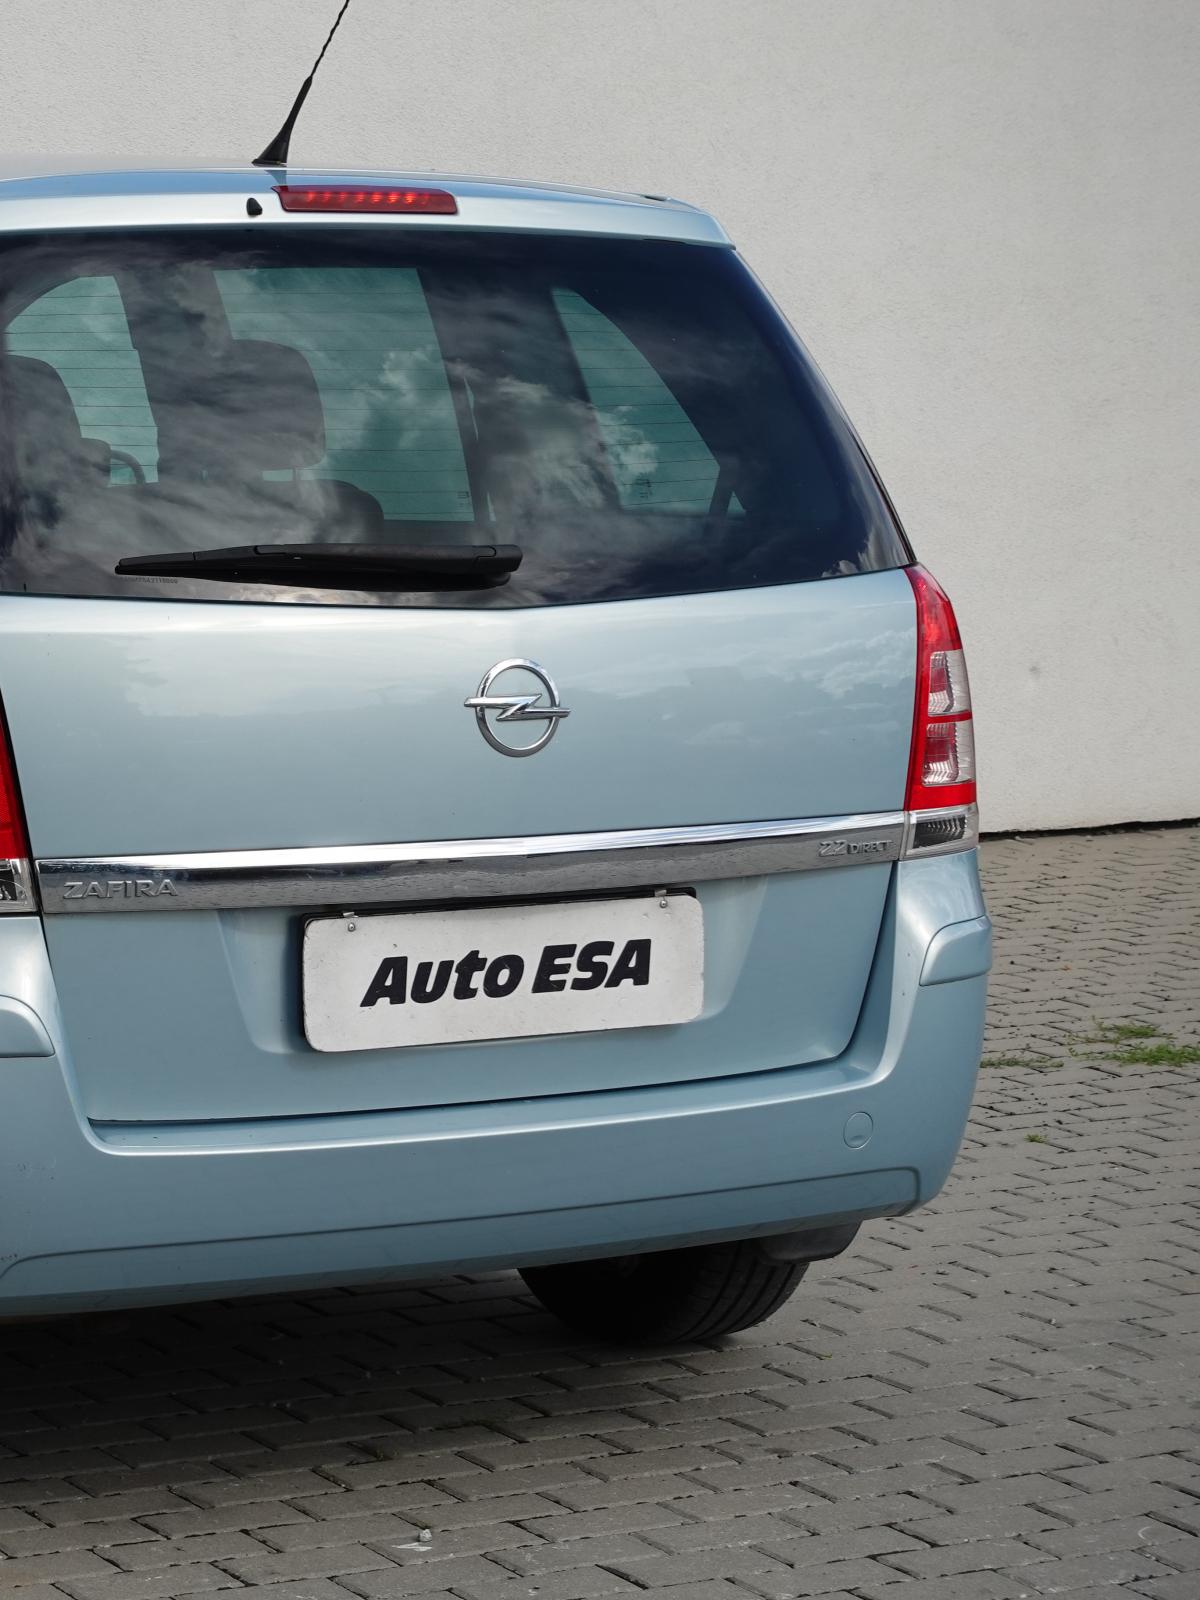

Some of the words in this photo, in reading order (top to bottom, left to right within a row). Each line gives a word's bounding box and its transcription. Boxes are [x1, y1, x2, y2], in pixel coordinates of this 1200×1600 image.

[847, 840, 894, 854] DIRECT
[63, 879, 178, 899] ZAFIRA
[360, 950, 525, 1007] Auto
[532, 938, 652, 993] ESA
